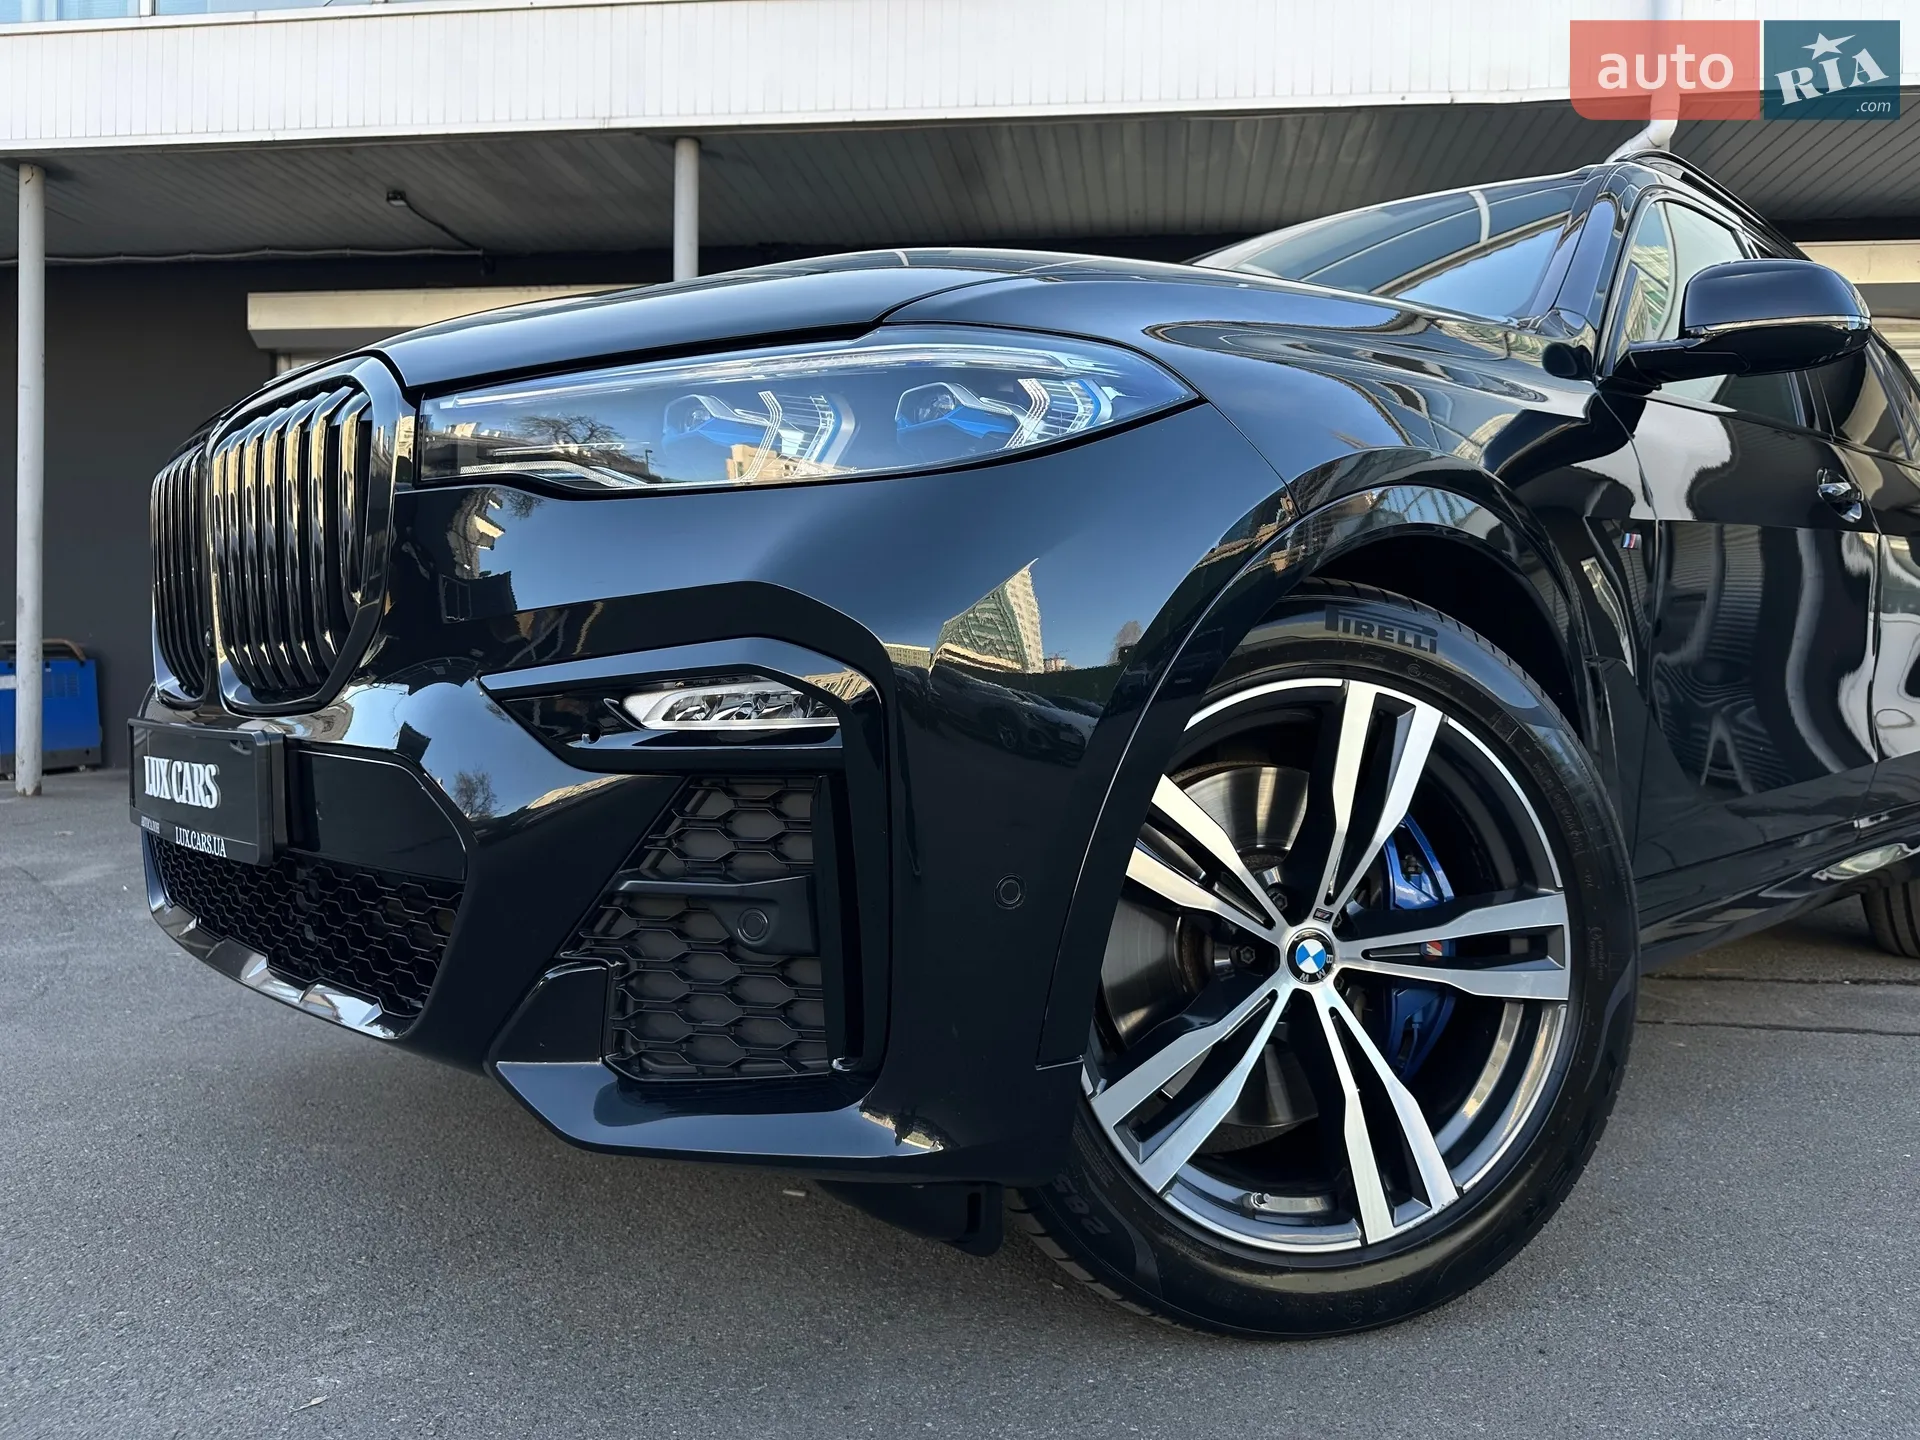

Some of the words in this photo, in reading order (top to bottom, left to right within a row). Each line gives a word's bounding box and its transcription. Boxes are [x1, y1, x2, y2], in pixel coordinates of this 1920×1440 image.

[1325, 604, 1438, 655] PIRELLI
[143, 756, 171, 800] LUX
[171, 760, 221, 809] CARS
